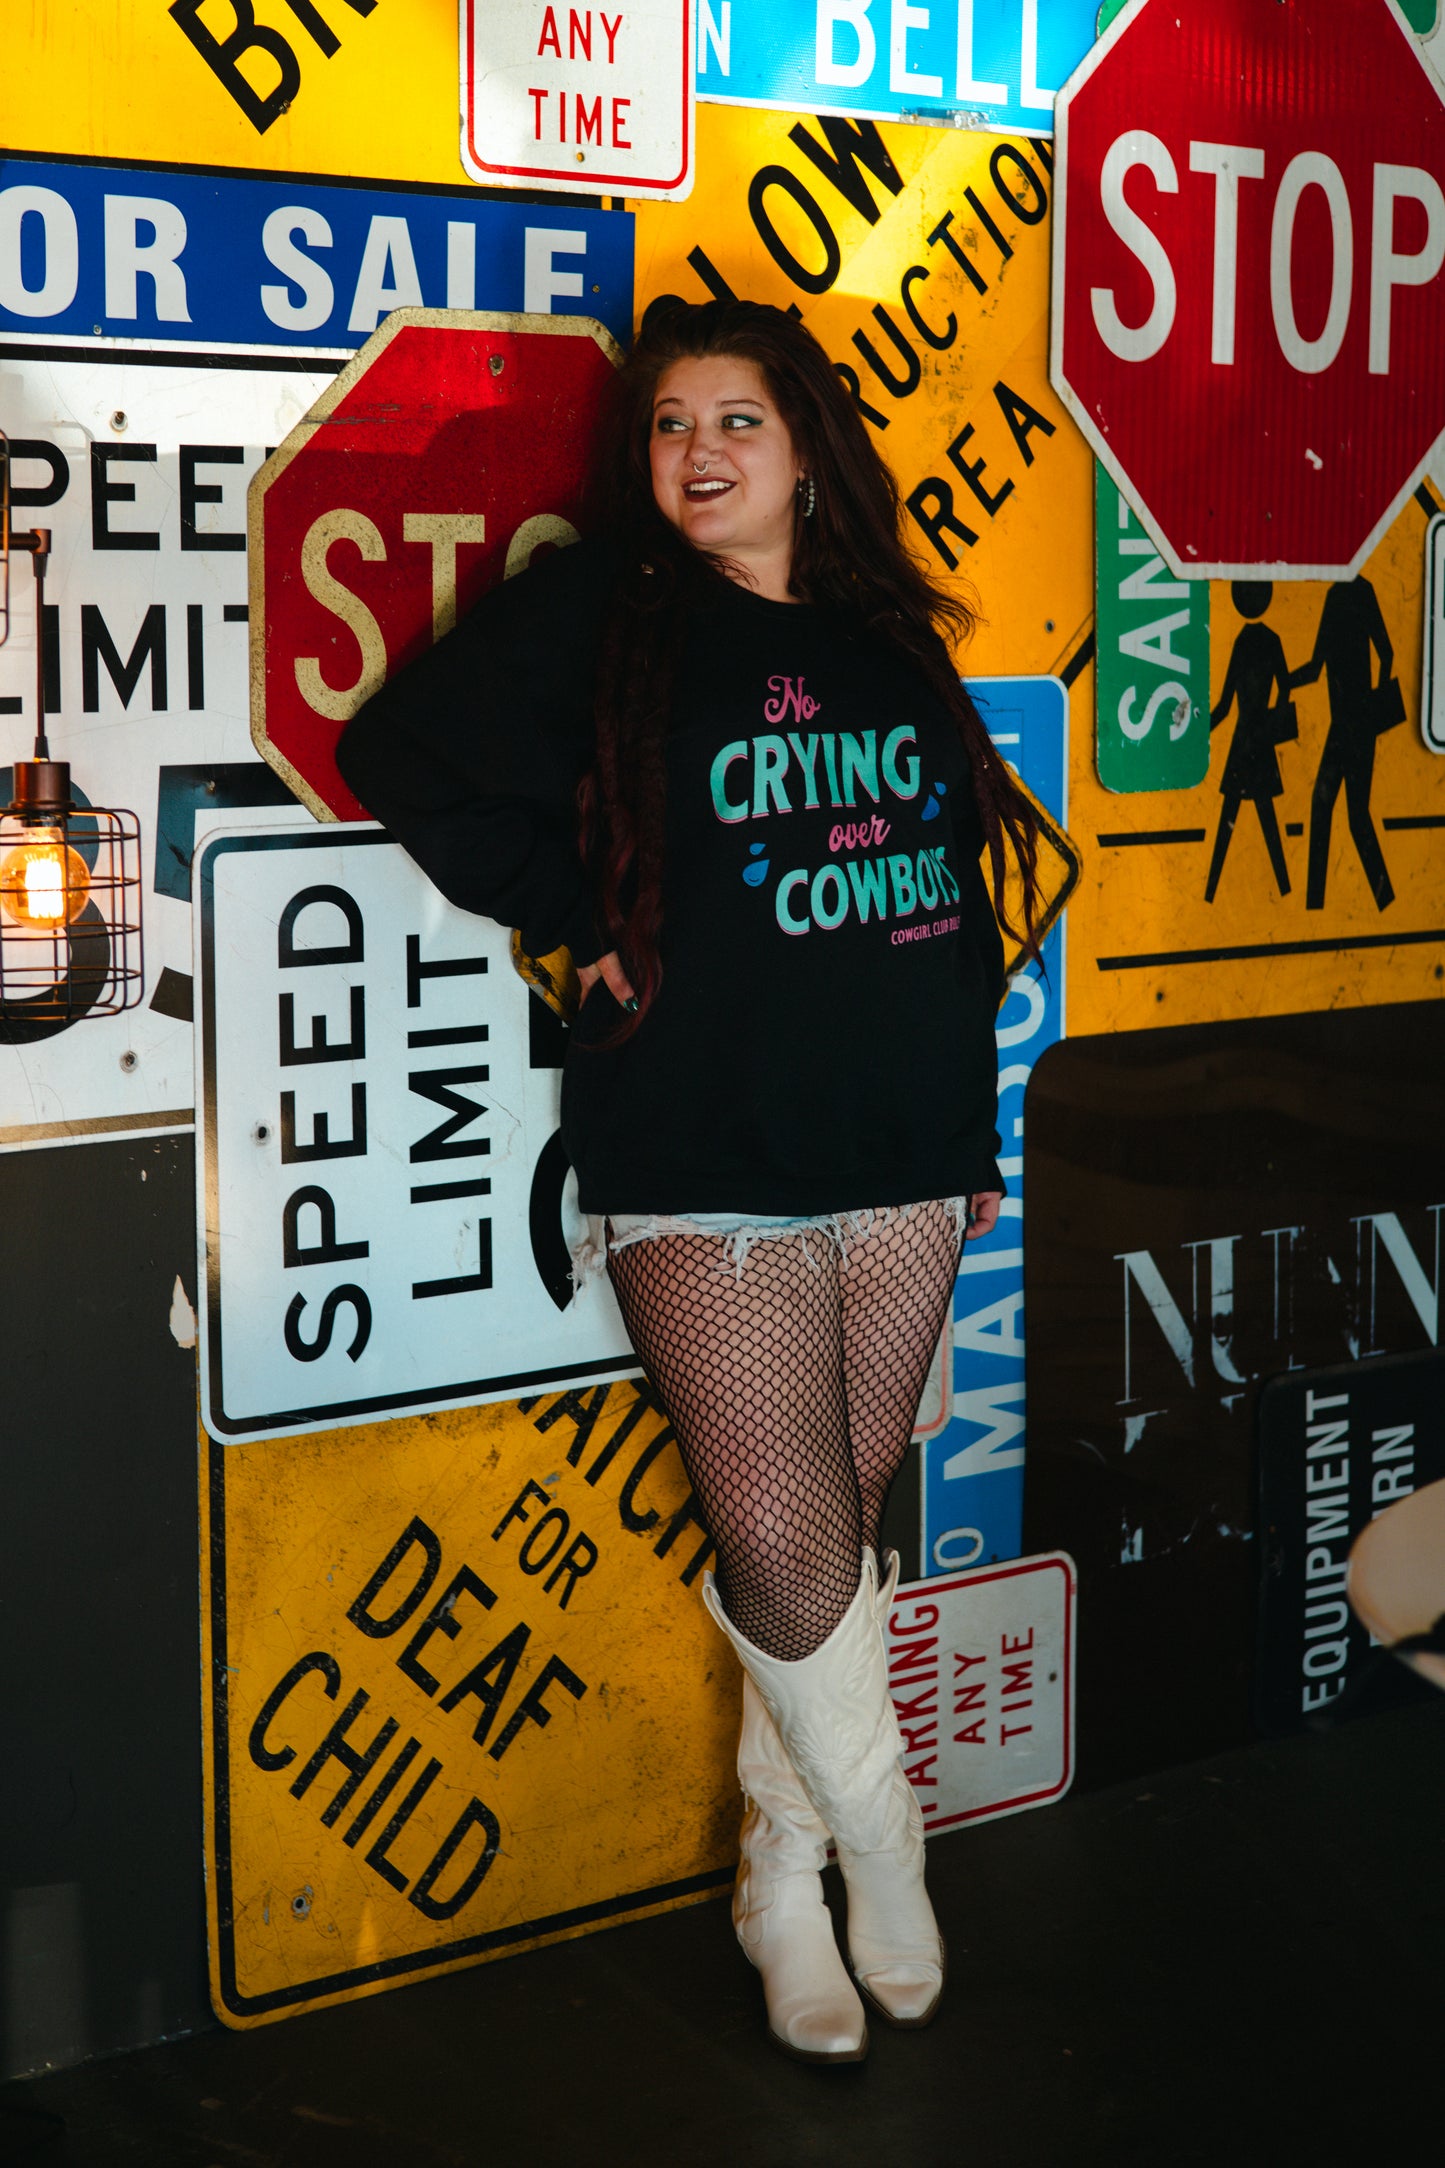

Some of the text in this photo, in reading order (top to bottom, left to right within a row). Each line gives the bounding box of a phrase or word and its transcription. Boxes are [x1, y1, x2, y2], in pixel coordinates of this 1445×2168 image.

[538, 6, 624, 64] ANY
[696, 0, 1055, 110] N BELL
[529, 88, 632, 150] TIME
[0, 185, 193, 323] OR
[642, 115, 905, 304] OW
[1090, 129, 1444, 376] STOP
[0, 438, 272, 552] PEE
[905, 380, 1057, 572] REA
[0, 604, 249, 715] IMI
[1117, 493, 1192, 742] SAN
[764, 675, 821, 723] No
[709, 725, 921, 824] CRYING
[828, 814, 891, 852] over
[775, 846, 961, 936] COWBOYS
[891, 923, 932, 945] COWGIRL
[933, 918, 949, 936] CLUB
[278, 884, 373, 1363] SPEED
[407, 934, 493, 1300] LIMIT
[490, 1478, 599, 1611] FOR
[1302, 1389, 1350, 1713] EQUIPMENT
[345, 1515, 588, 1763] DEAF
[953, 1653, 986, 1744] ANY
[1000, 1627, 1034, 1747] TIME
[248, 1651, 500, 1922] CHILD
